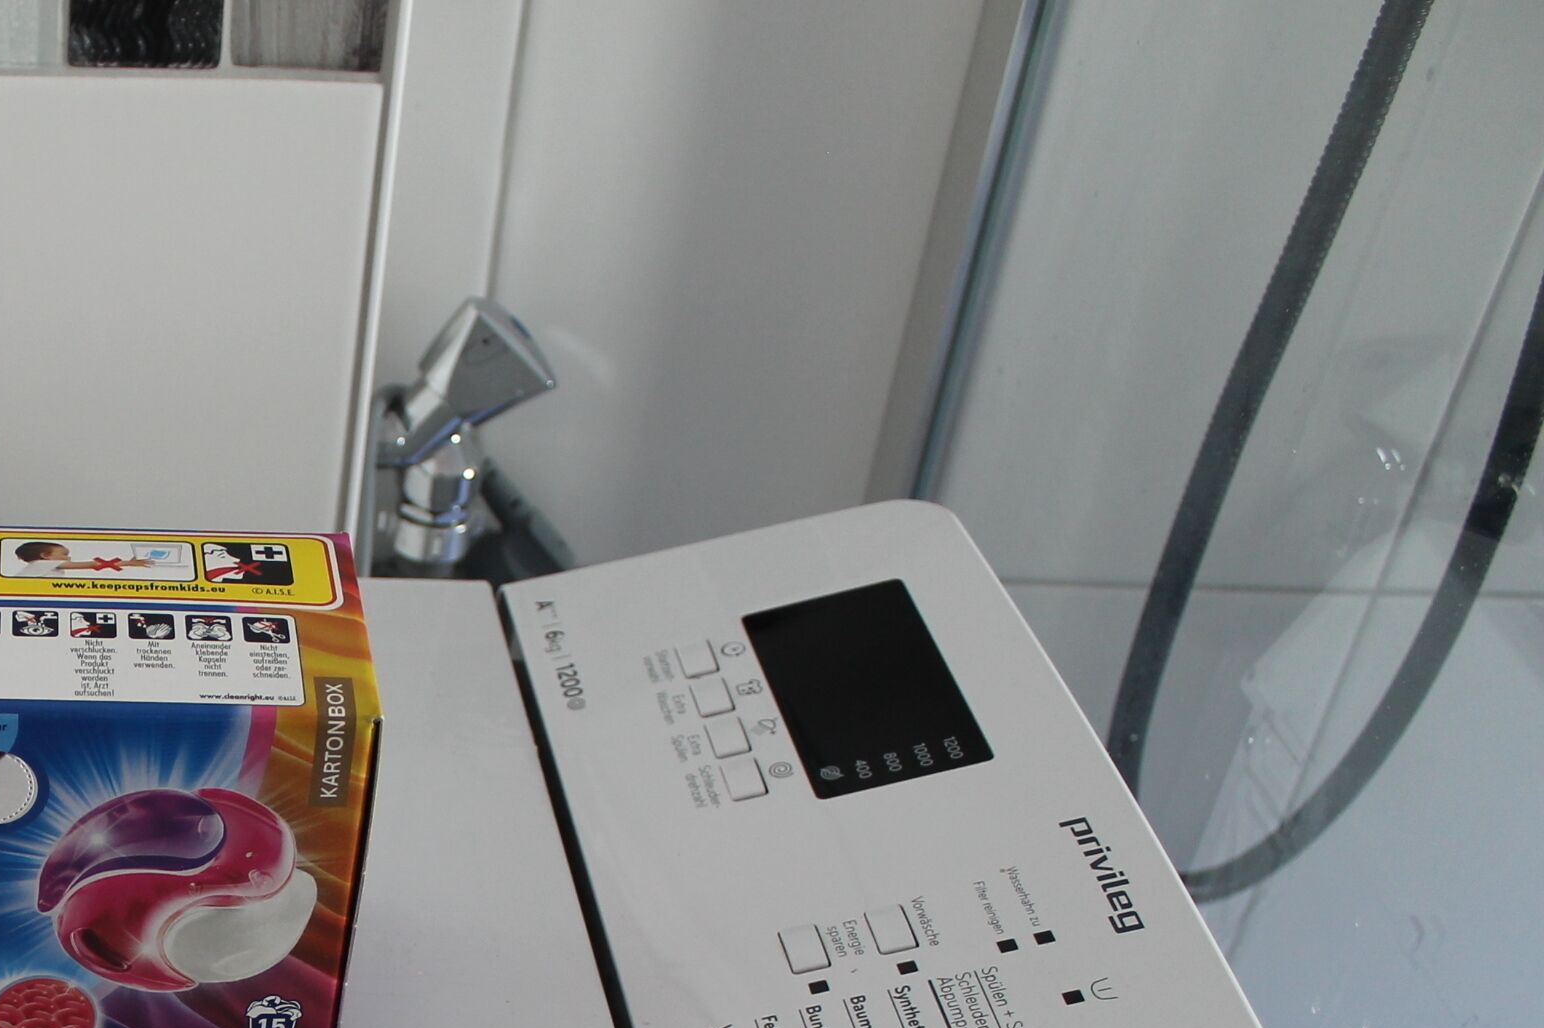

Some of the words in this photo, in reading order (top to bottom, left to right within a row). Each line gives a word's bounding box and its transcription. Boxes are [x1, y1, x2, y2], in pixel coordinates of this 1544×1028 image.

[52, 581, 226, 593] www.keepcapsfromkids.eu
[199, 656, 226, 664] Kapseln
[555, 663, 583, 698] 1200
[883, 752, 902, 772] 800
[913, 743, 934, 767] 1000
[944, 736, 964, 759] 1200
[856, 760, 872, 779] 400
[1058, 817, 1145, 934] privileg
[973, 880, 989, 902] Filter
[982, 902, 1004, 935] reinigen
[1007, 866, 1036, 915] Wasserhahn
[1031, 915, 1041, 927] zu
[911, 895, 940, 947] Vorwäsche
[827, 926, 847, 958] sparen
[842, 919, 865, 957] Energie
[981, 965, 1009, 1008] Spülen
